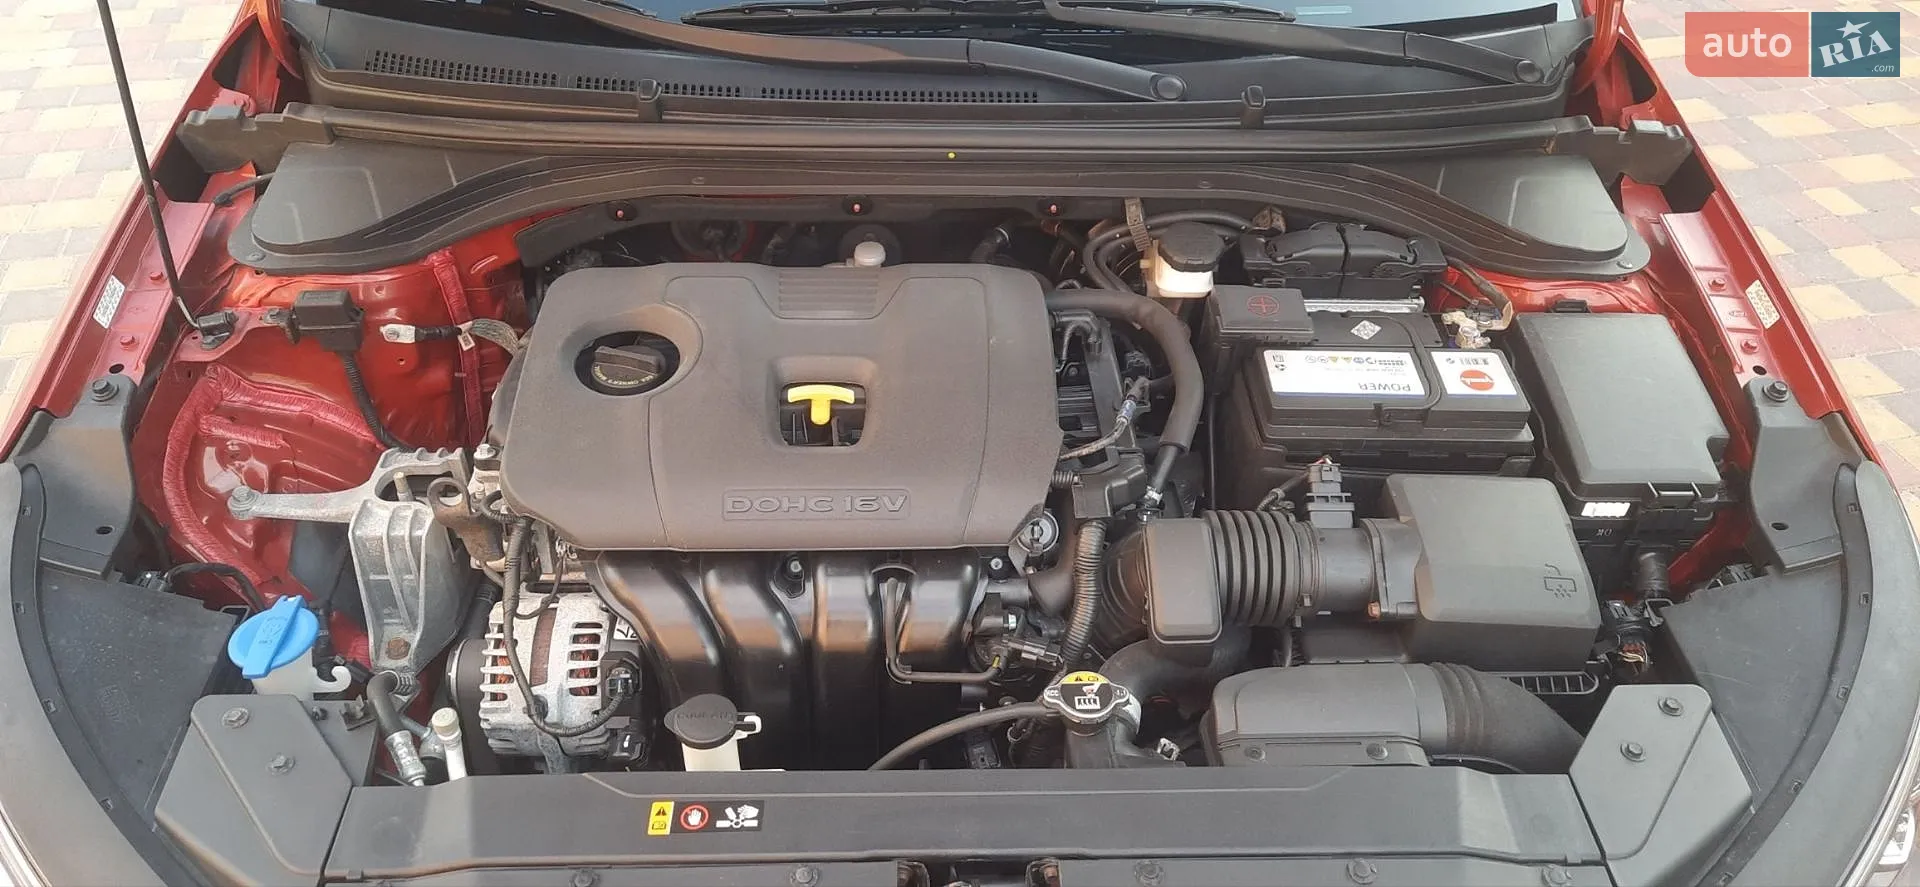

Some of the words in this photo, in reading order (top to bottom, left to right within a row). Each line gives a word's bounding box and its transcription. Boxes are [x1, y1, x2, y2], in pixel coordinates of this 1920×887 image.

[1358, 382, 1411, 392] POWER
[726, 496, 834, 514] DOHC
[844, 495, 908, 513] 16V
